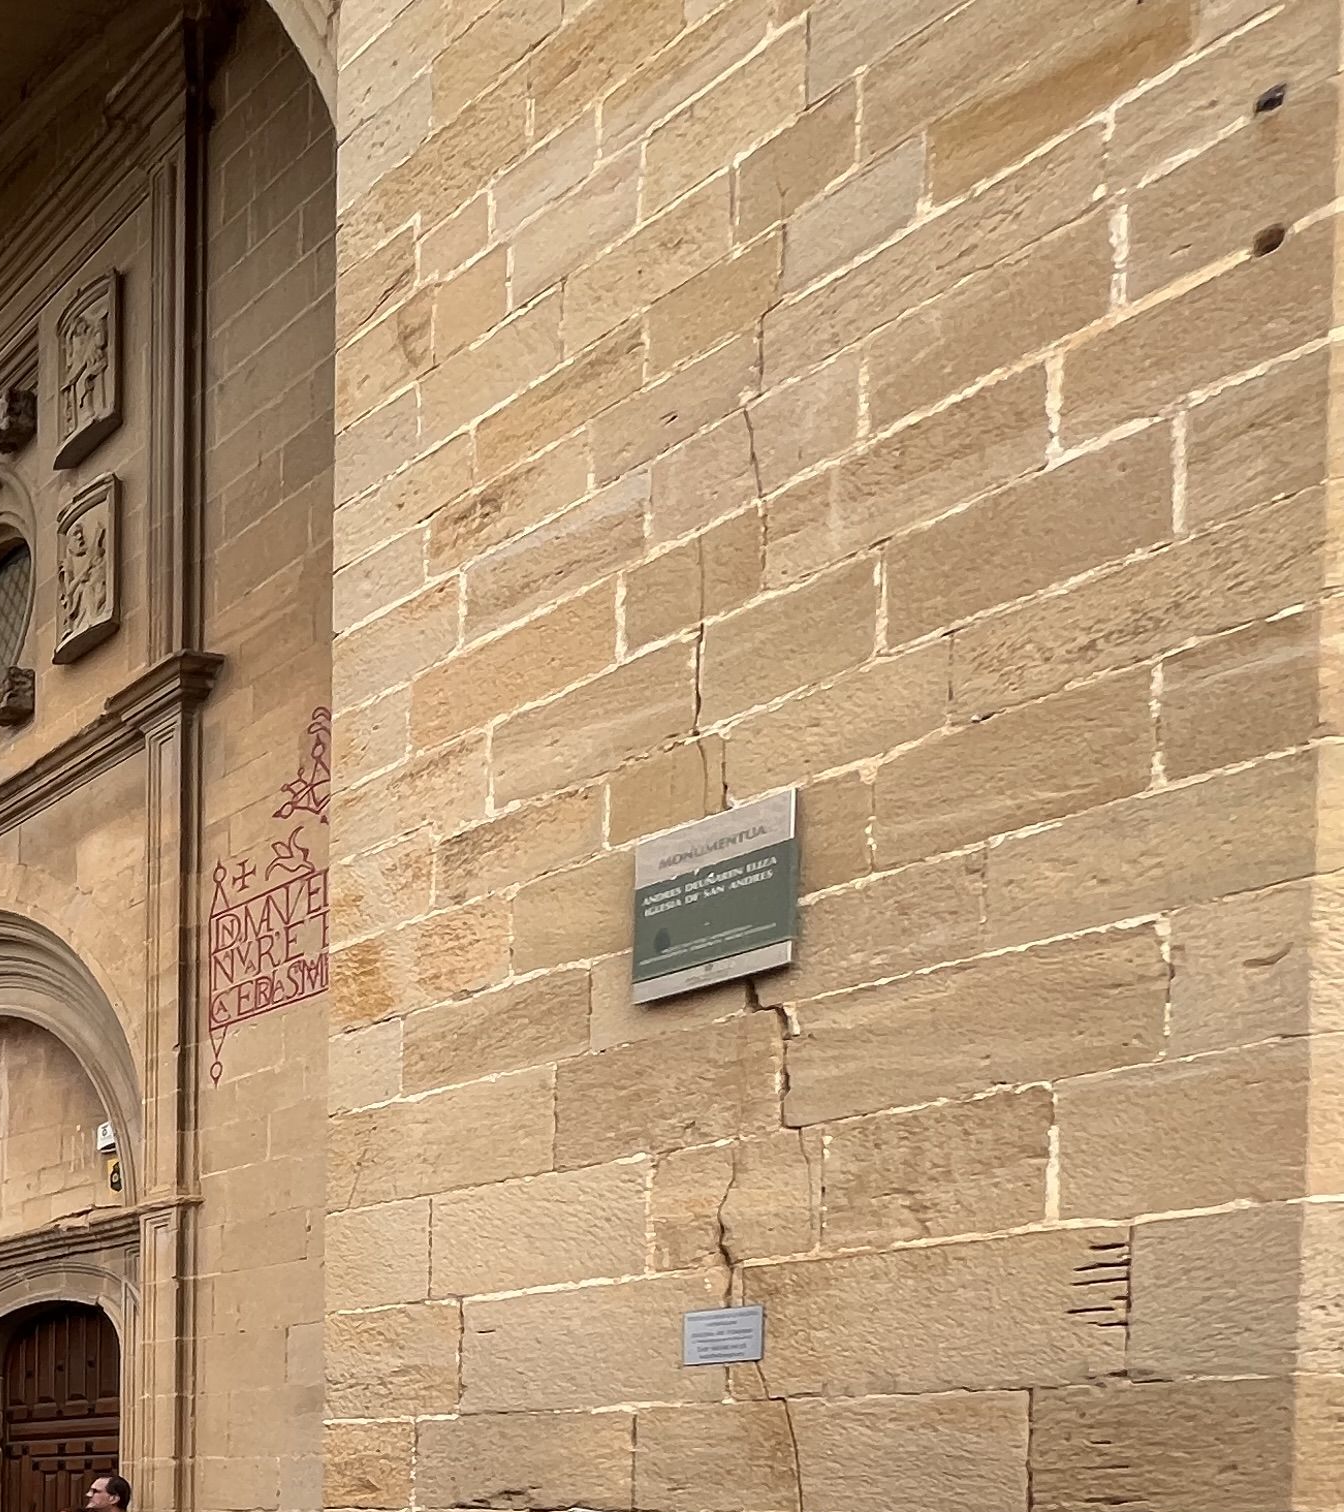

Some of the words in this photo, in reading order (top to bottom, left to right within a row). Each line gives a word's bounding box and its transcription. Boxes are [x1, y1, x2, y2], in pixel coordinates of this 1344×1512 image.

[658, 824, 767, 871] MONUMENTUA
[641, 887, 682, 907] ANDRES
[644, 900, 682, 918] IGLESIA
[685, 893, 700, 905] DE
[703, 886, 725, 899] SAN
[729, 870, 773, 889] ANDRES
